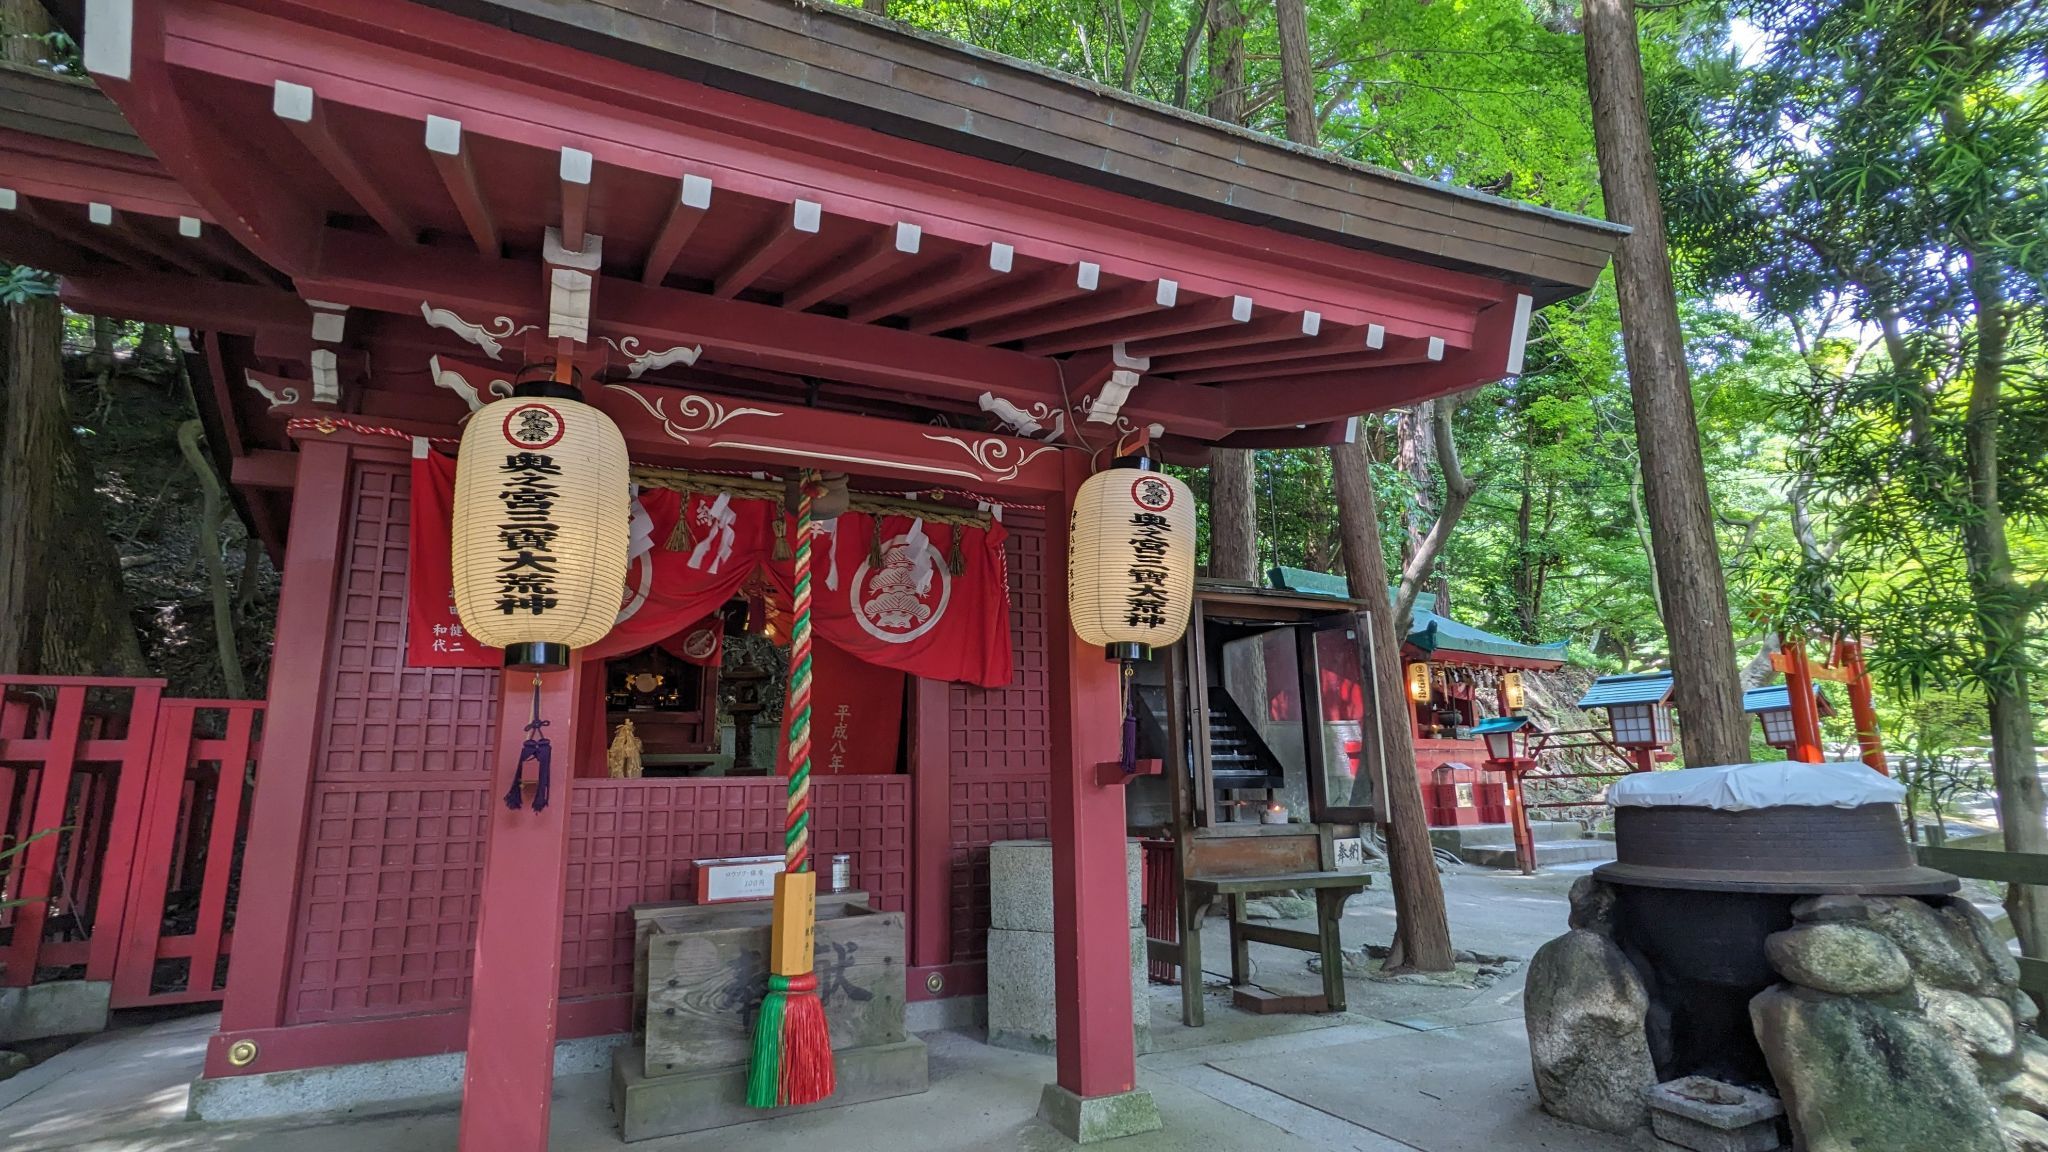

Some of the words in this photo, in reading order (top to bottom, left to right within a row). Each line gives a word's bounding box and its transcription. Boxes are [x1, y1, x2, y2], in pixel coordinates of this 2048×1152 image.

[432, 623, 447, 652] 和代
[828, 704, 851, 774] 平成八年
